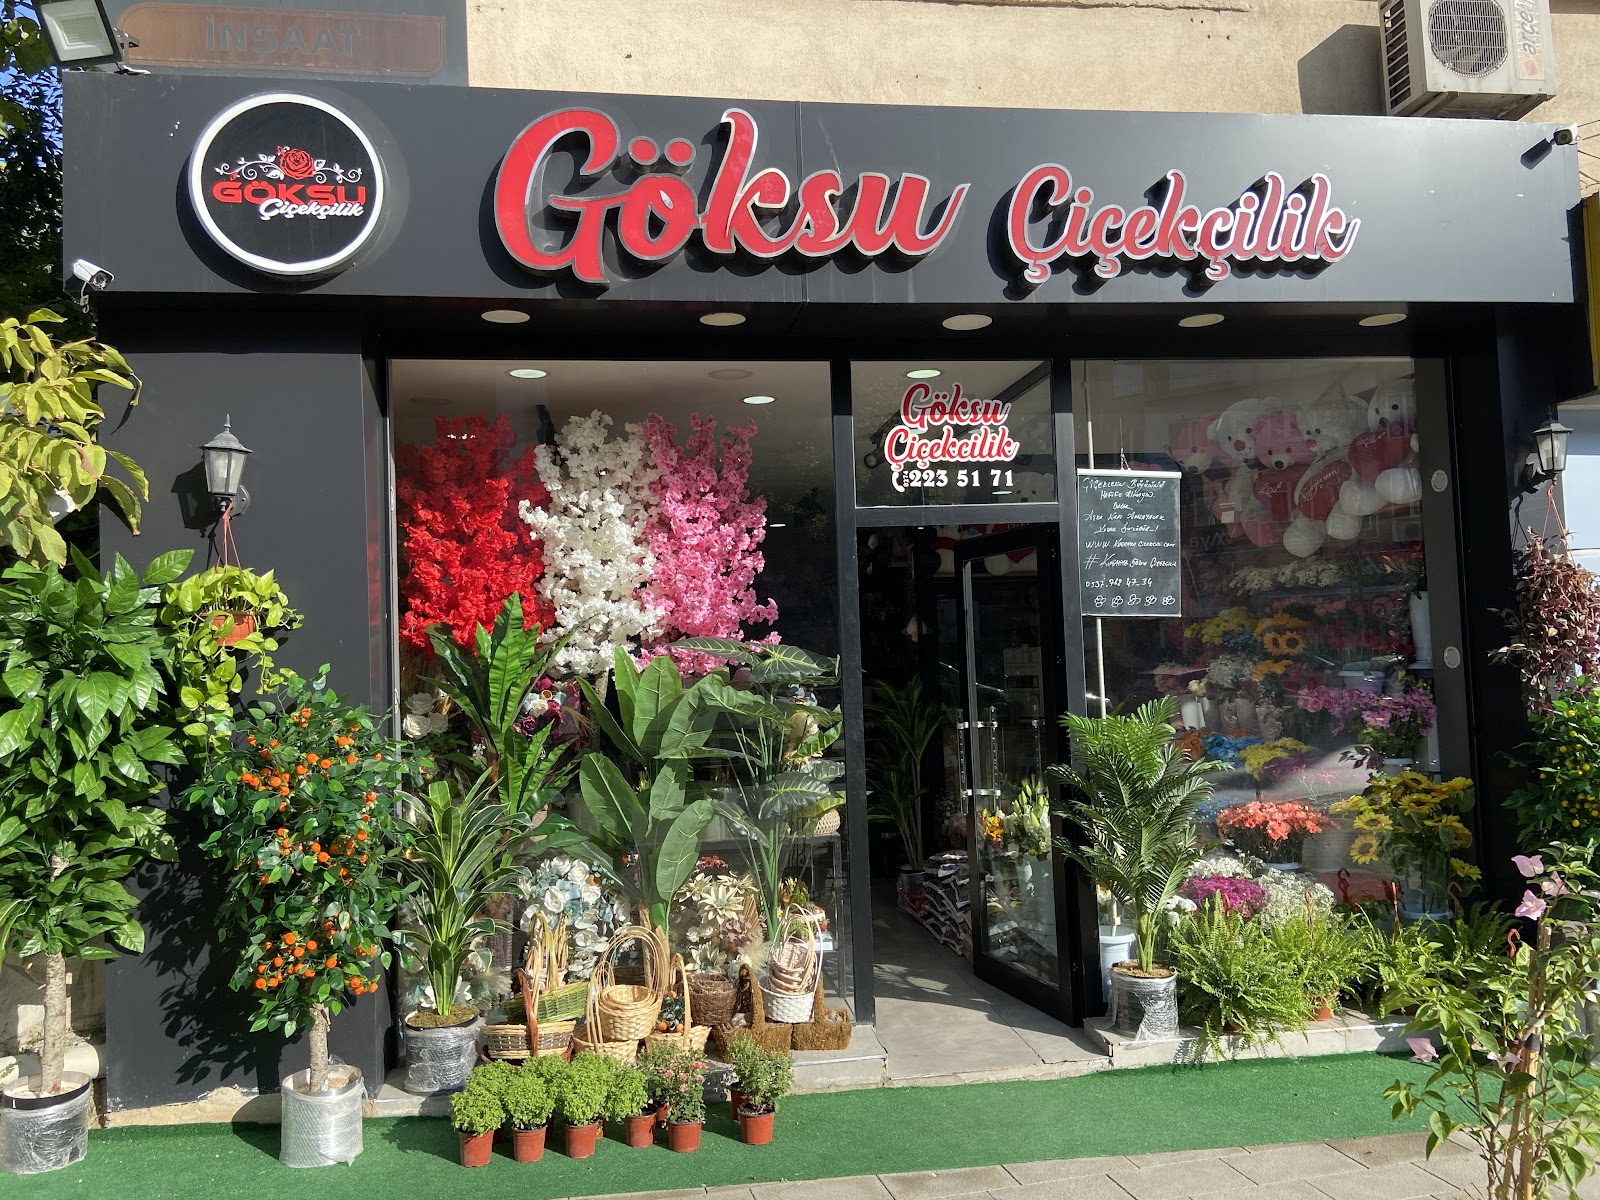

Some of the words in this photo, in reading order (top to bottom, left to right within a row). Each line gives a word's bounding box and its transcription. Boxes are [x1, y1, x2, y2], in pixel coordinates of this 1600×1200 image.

[212, 180, 366, 206] GÖKSU
[494, 107, 971, 284] Göksu
[1006, 163, 1362, 284] Çiçekçilik
[259, 198, 365, 221] Çiçekçilik
[900, 382, 1012, 431] Göksu
[909, 469, 949, 487] 223
[956, 469, 981, 487] 51
[990, 469, 1014, 487] 71
